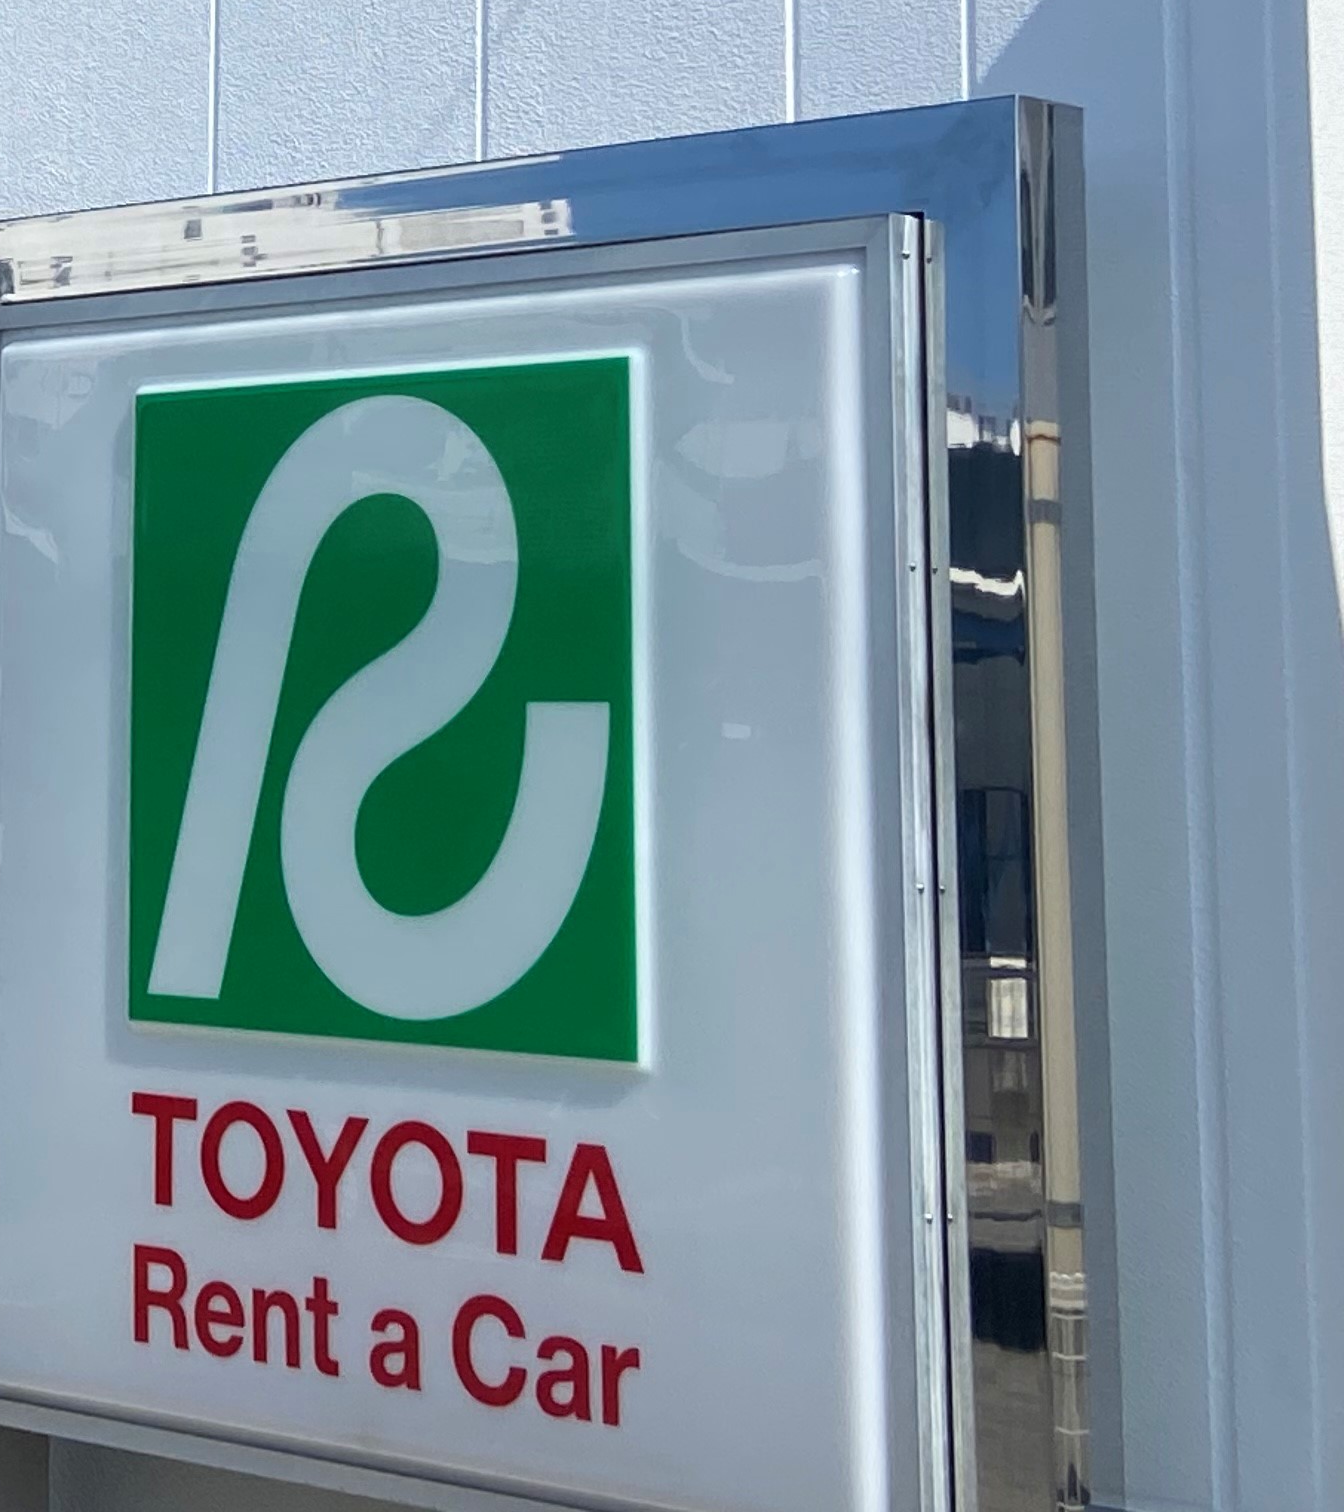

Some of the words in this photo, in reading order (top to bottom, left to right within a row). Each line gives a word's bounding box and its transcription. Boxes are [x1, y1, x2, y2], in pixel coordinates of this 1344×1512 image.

[131, 1091, 644, 1274] TOYOTA
[132, 1243, 340, 1377] Rent
[369, 1308, 422, 1391] a
[451, 1294, 640, 1426] Car
